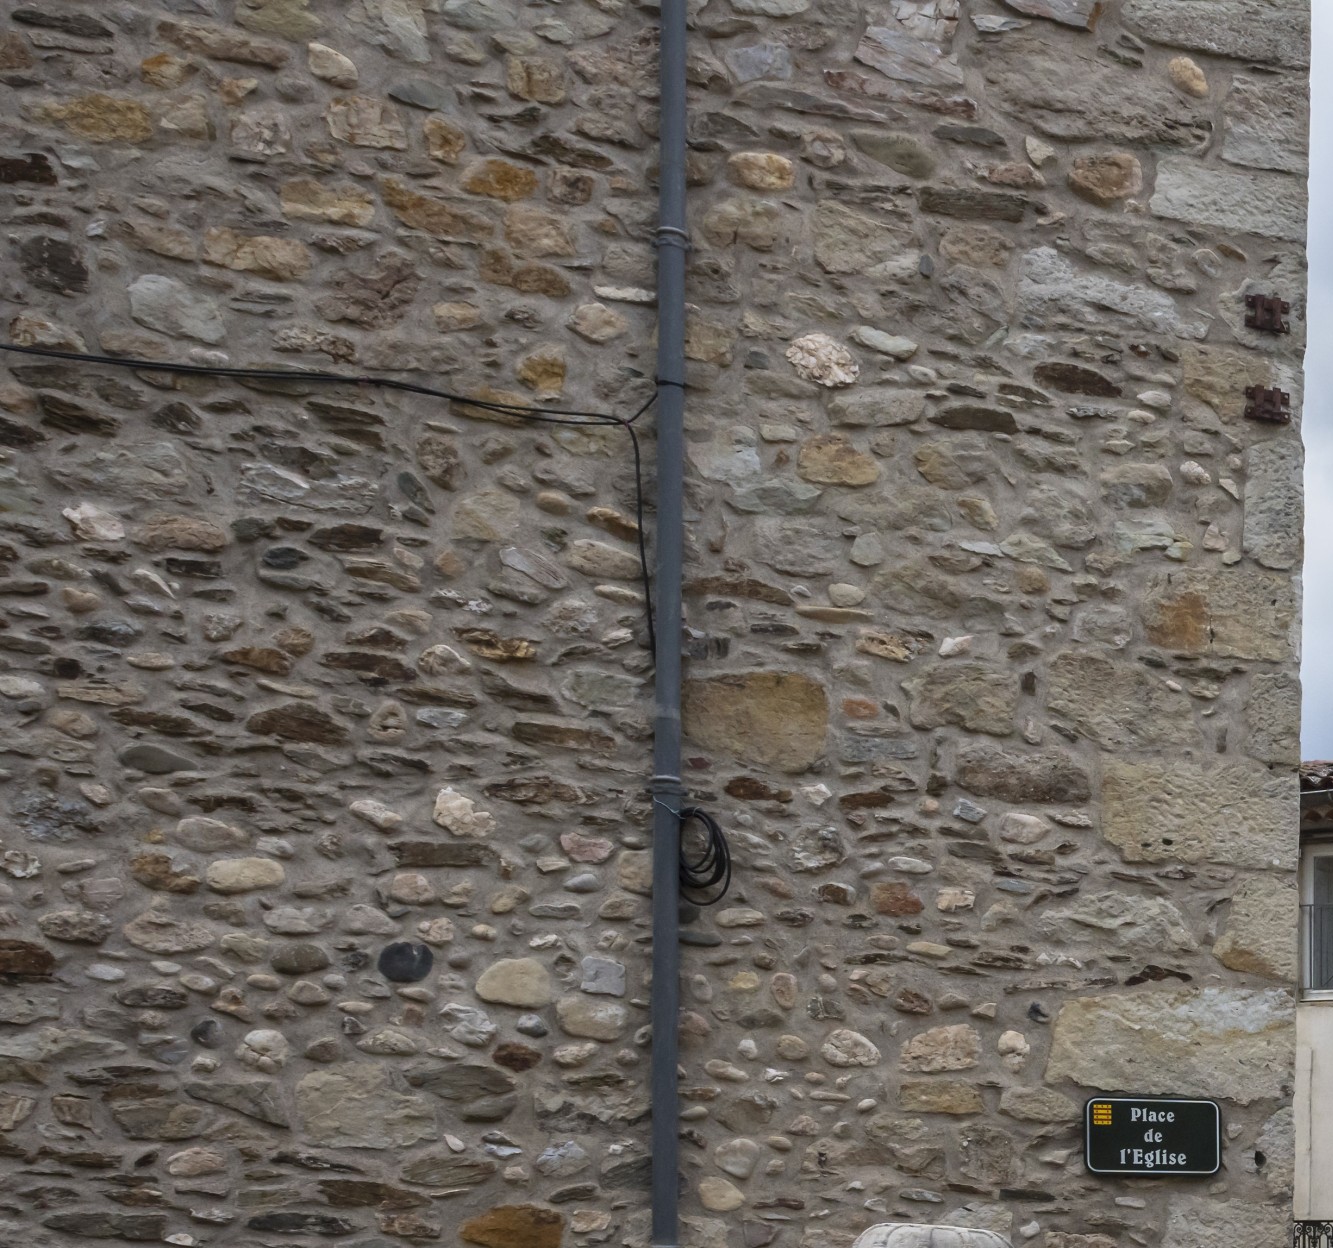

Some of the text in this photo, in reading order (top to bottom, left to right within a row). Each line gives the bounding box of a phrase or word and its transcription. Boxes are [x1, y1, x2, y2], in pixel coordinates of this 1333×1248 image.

[1130, 1107, 1175, 1122] Place
[1144, 1128, 1163, 1143] de
[1119, 1148, 1187, 1168] l'Eglise
